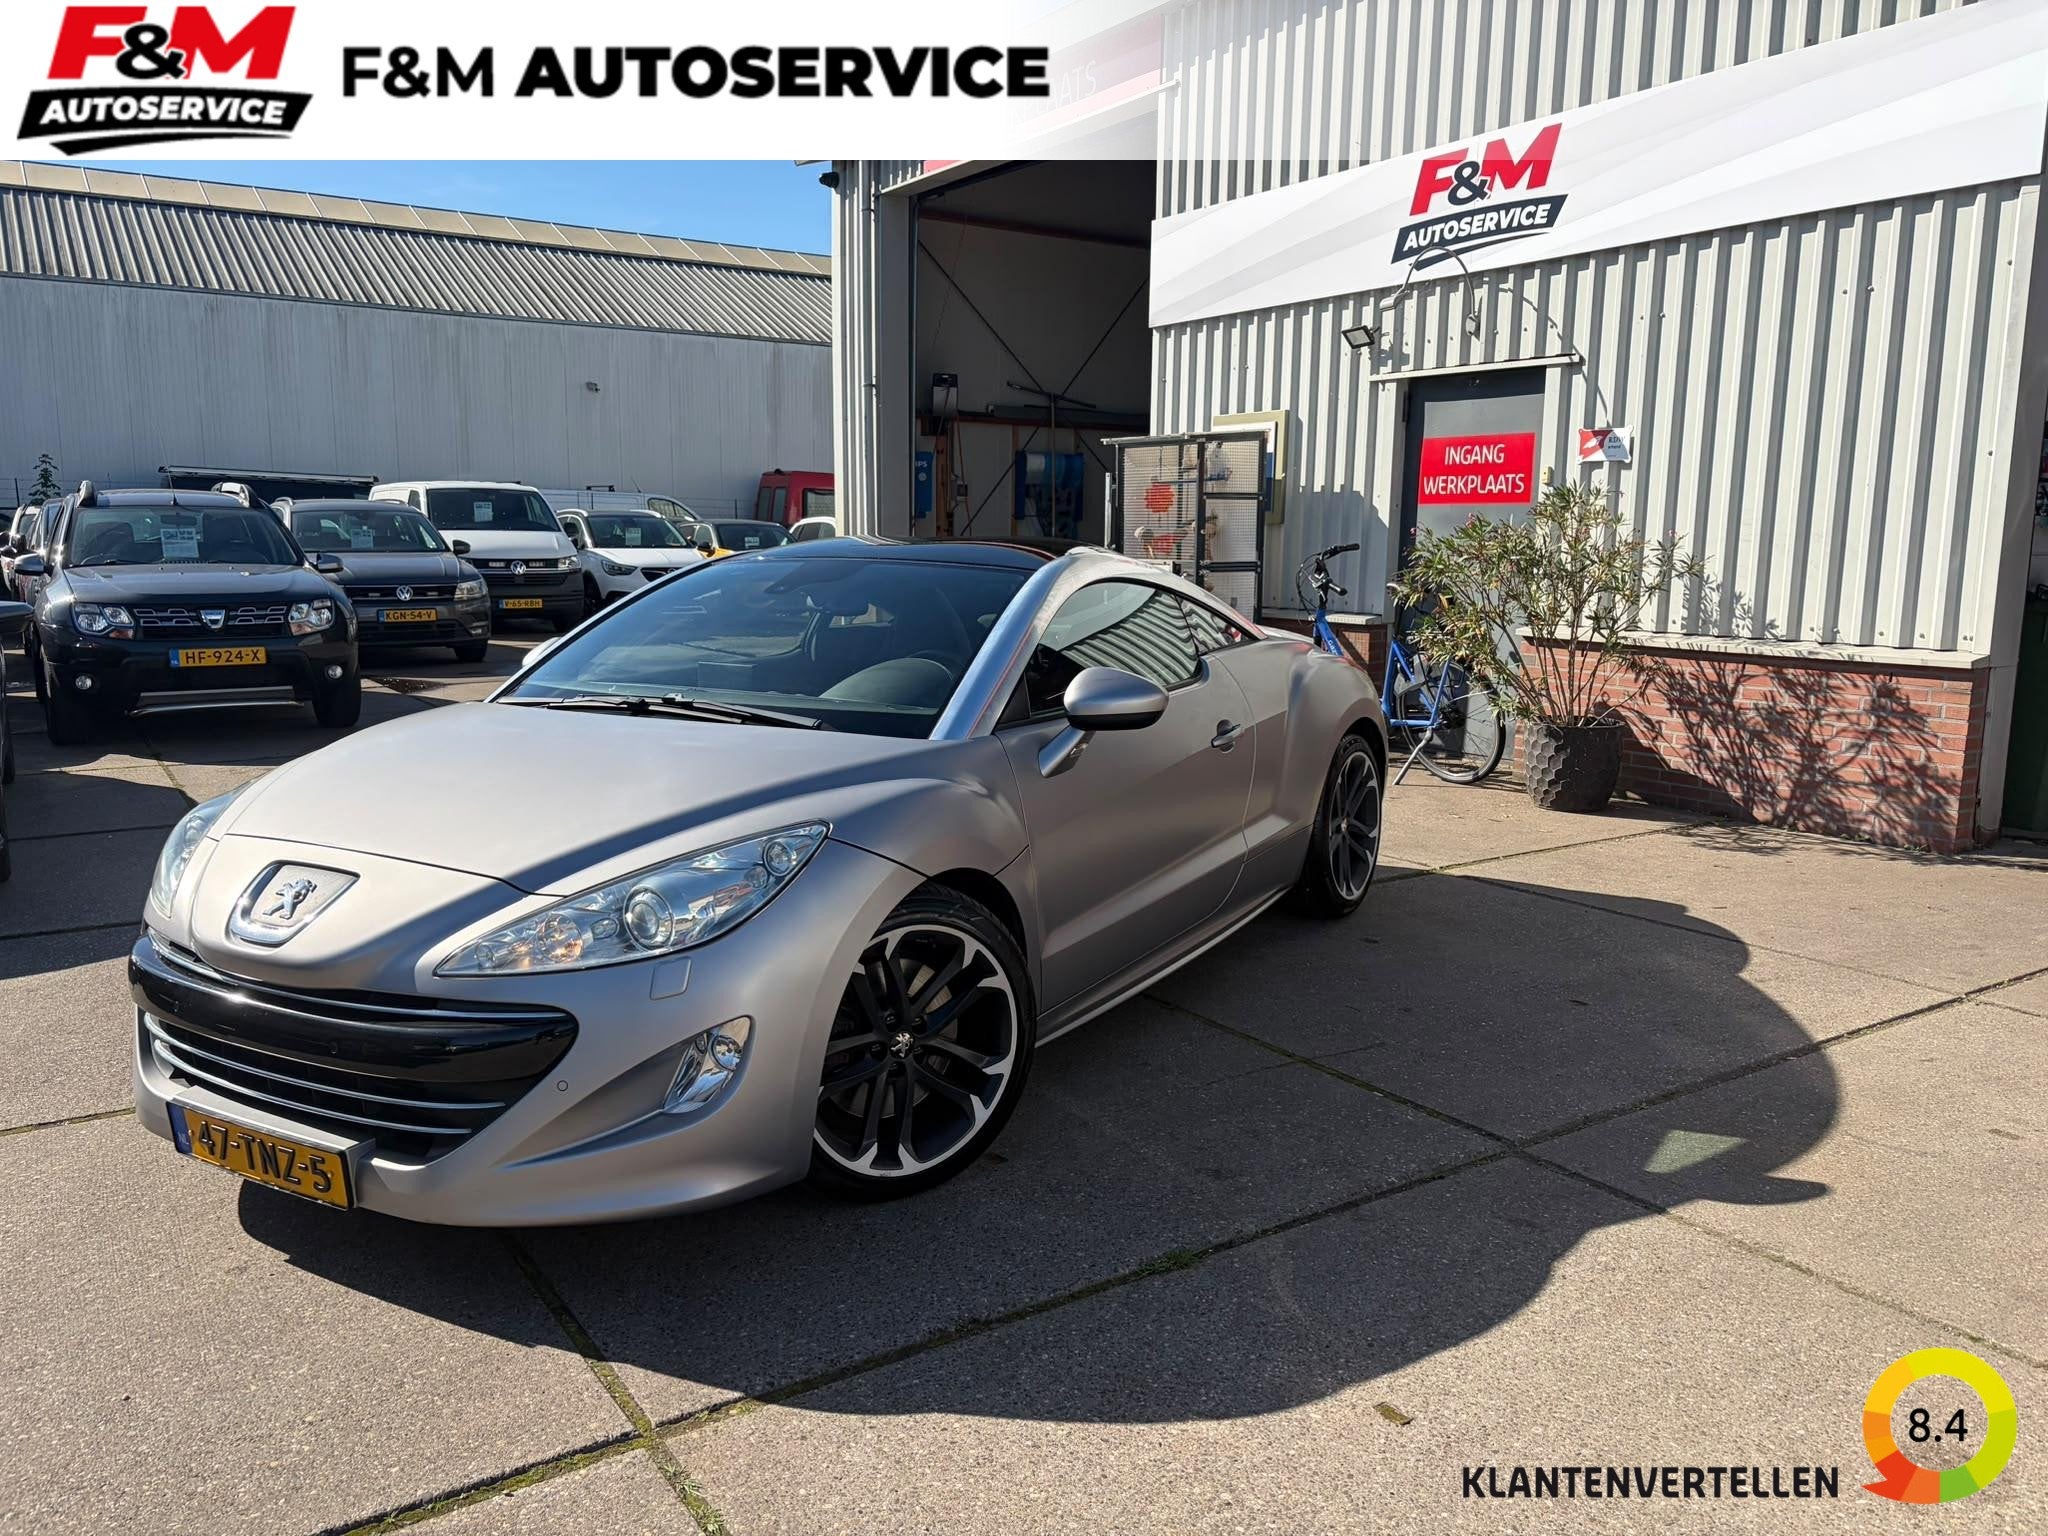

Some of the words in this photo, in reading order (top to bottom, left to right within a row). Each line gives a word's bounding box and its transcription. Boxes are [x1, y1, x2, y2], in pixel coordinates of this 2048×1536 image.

[1409, 122, 1563, 217] F&M
[1402, 203, 1552, 252] AUTOSERVICE
[1444, 443, 1505, 466] INGANG
[1423, 473, 1525, 495] WERKPLAATS
[385, 610, 432, 621] KGN-54-V
[185, 648, 260, 665] HF-924-X
[198, 1120, 332, 1193] 47-TNZ-5
